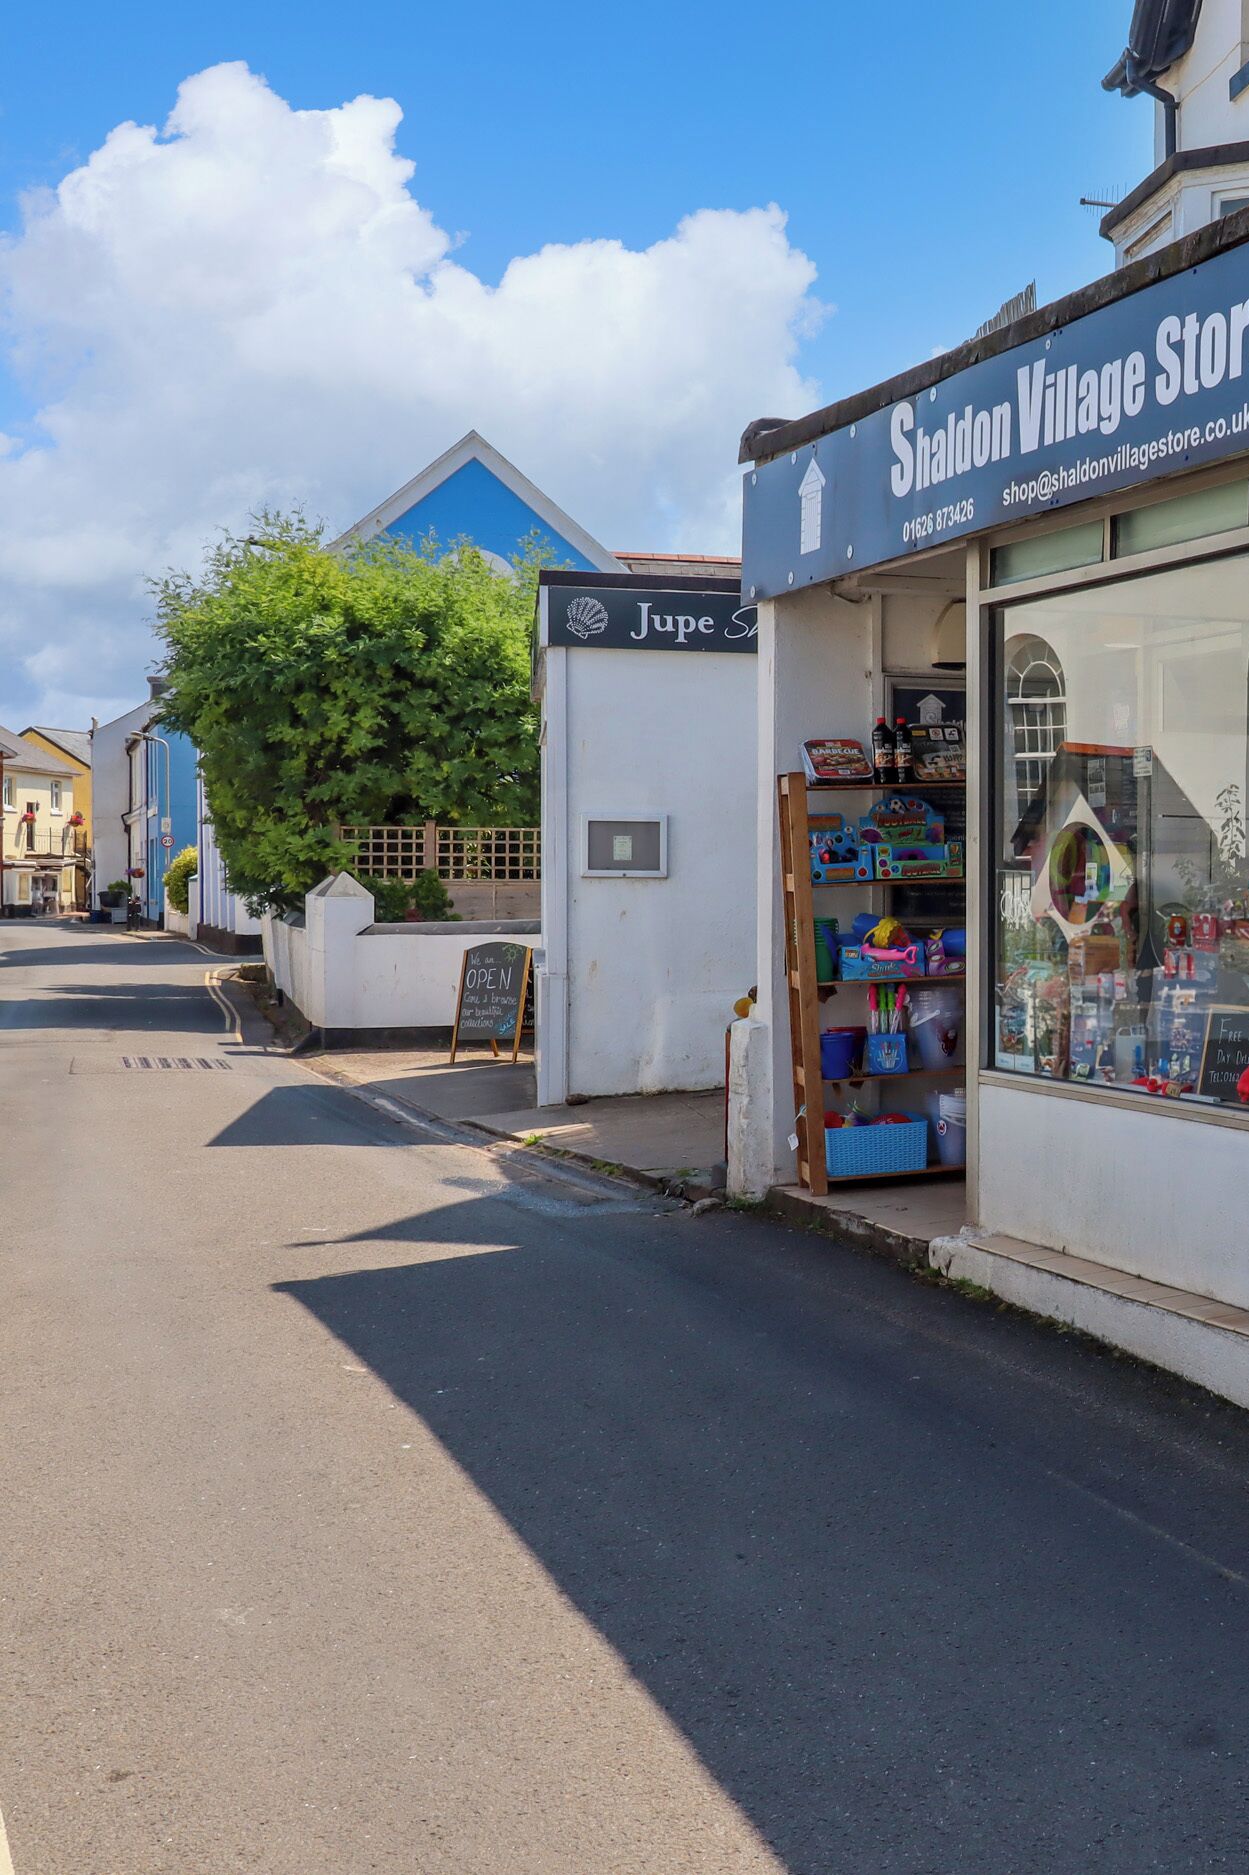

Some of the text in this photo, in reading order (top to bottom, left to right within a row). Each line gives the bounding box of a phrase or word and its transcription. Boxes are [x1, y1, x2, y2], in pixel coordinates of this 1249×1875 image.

[890, 401, 1012, 498] Shaldon
[1017, 358, 1146, 455] Village
[903, 497, 974, 543] 01626 873426
[630, 602, 714, 643] Jupe
[466, 966, 513, 990] OPEN
